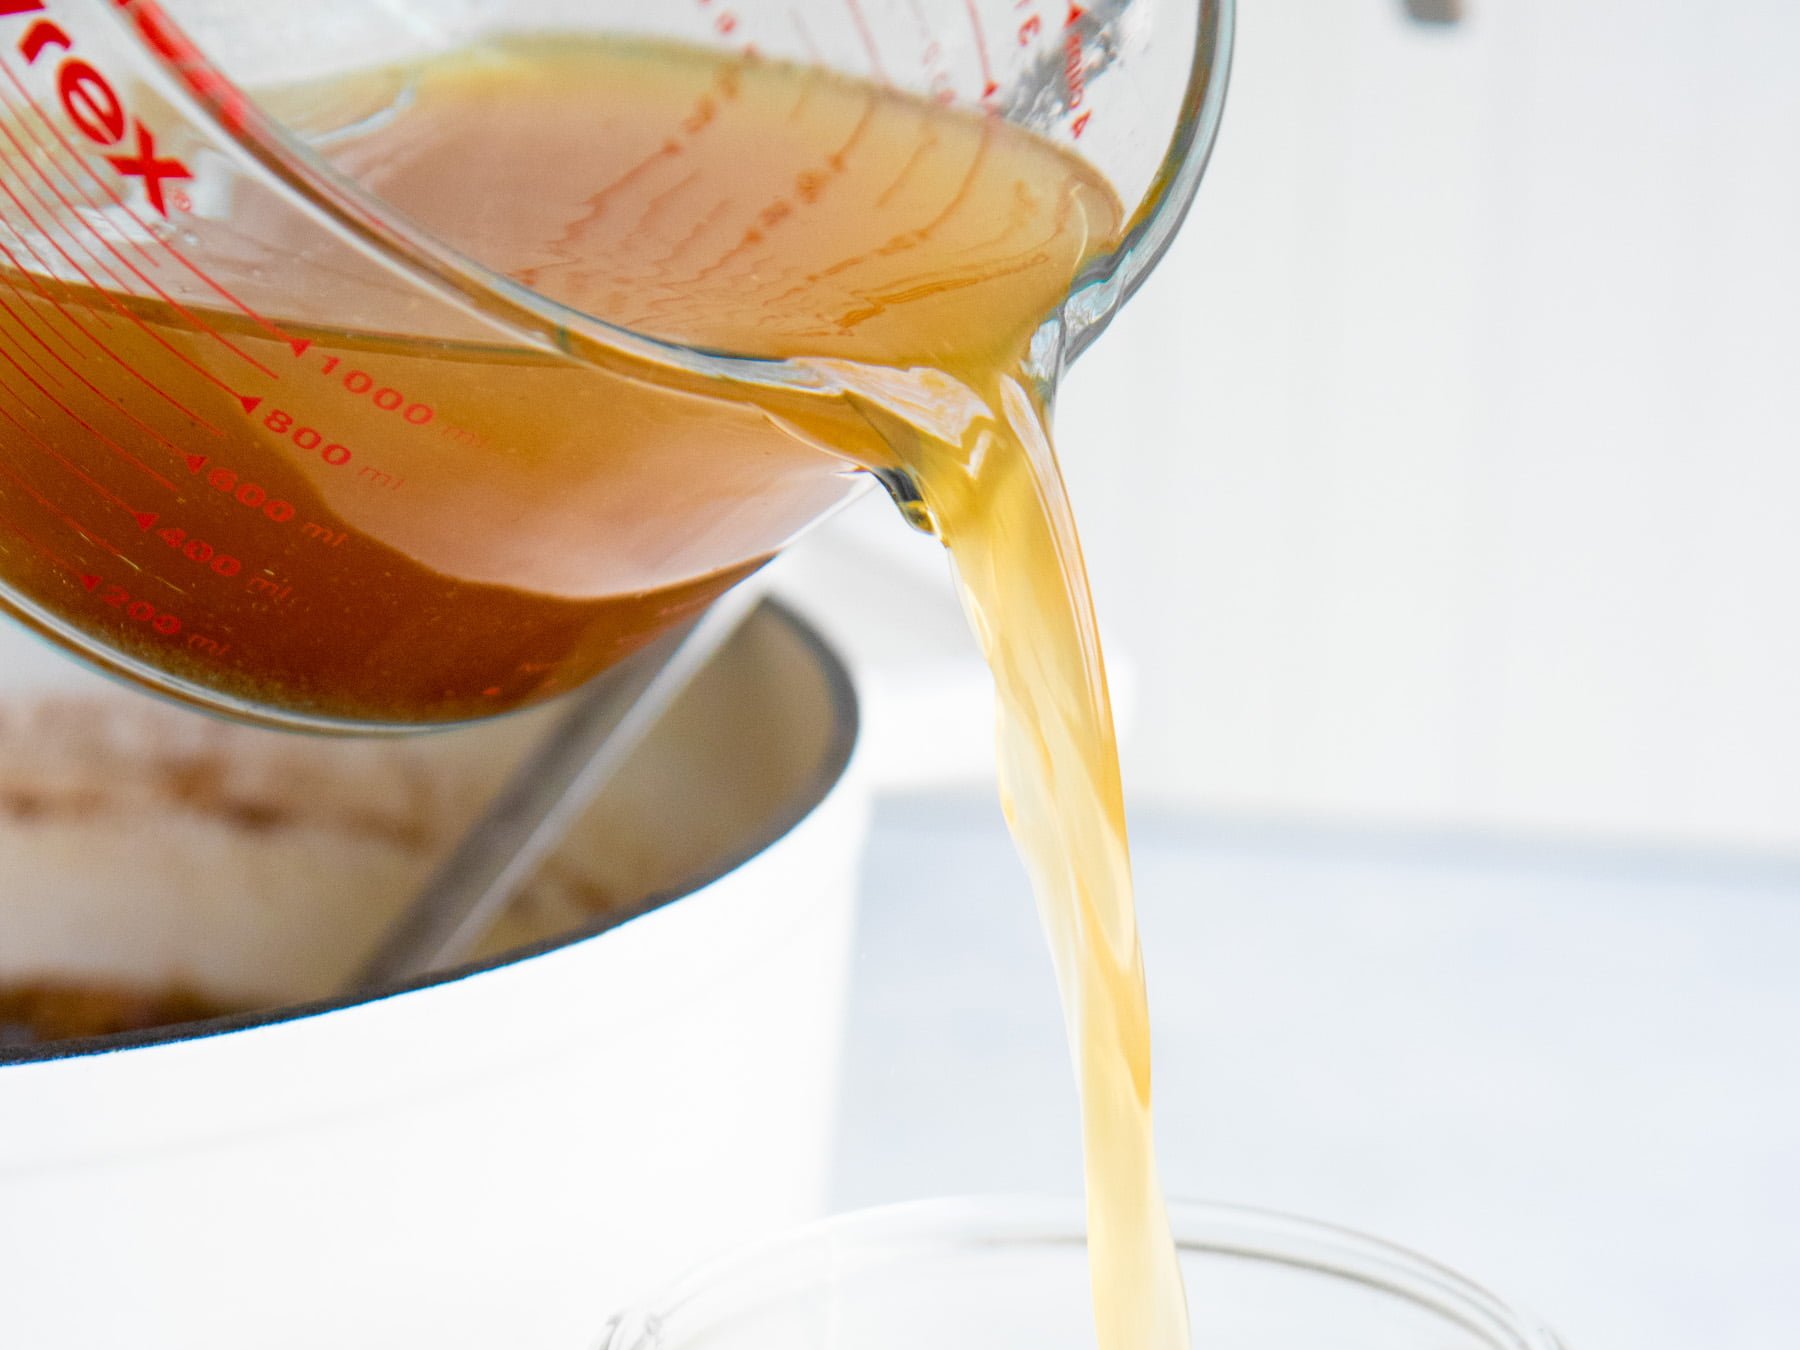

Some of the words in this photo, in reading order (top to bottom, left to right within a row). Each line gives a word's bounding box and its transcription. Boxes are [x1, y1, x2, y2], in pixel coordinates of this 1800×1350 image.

[321, 355, 434, 425] 1000
[263, 409, 352, 466] 800
[208, 467, 295, 522] 600
[157, 528, 241, 576] 400
[102, 585, 181, 634] 200
